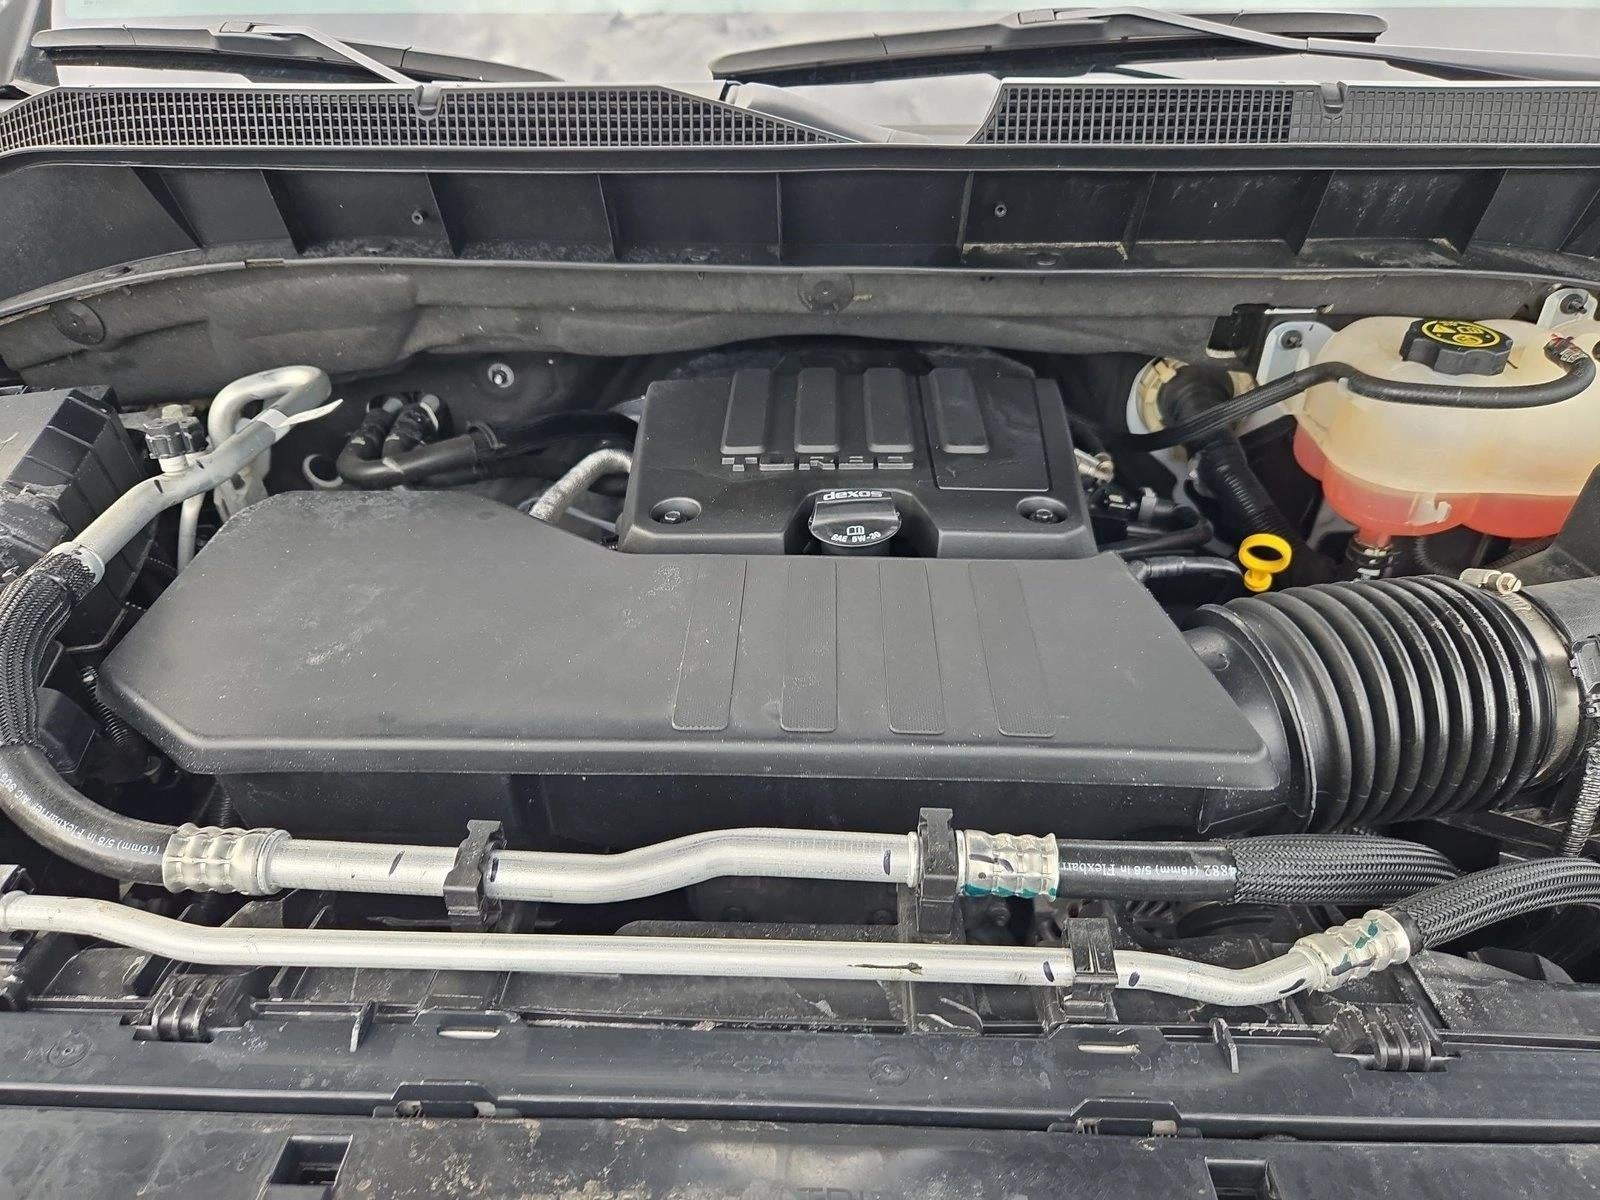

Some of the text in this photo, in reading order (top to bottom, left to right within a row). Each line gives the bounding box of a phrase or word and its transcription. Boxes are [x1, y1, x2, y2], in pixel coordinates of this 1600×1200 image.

[823, 490, 883, 500] dexos
[830, 533, 848, 542] SAE
[34, 802, 86, 840] Flexbarrier
[97, 836, 115, 849] 5/8
[117, 840, 160, 856] (16mm)
[1120, 864, 1133, 875] in
[1133, 865, 1153, 876] 5/8
[1156, 864, 1199, 877] (16mm)
[1203, 863, 1237, 877] 4882
